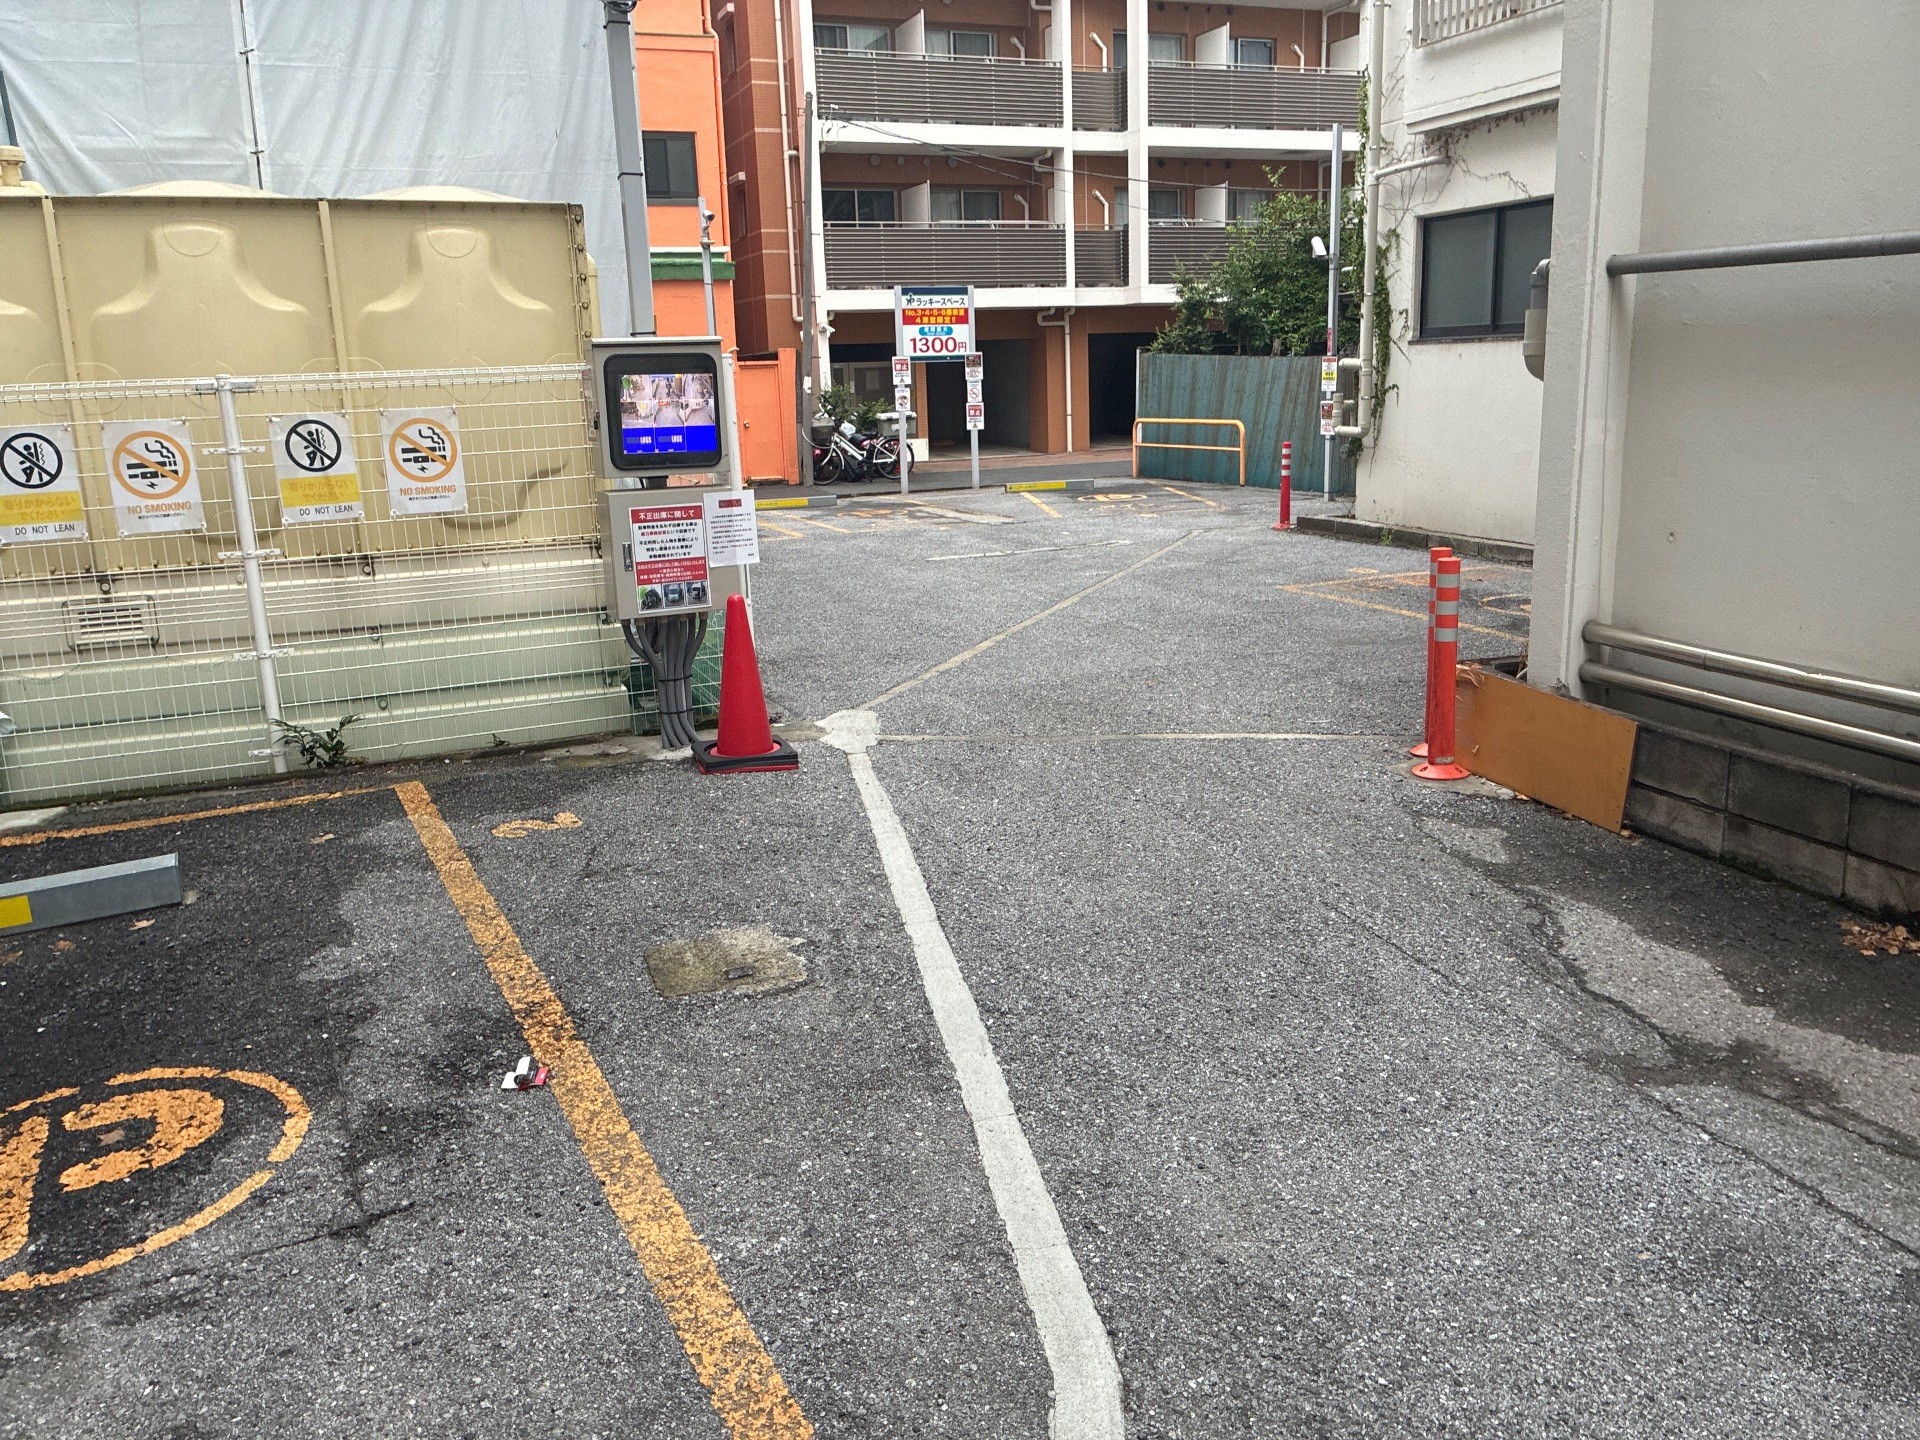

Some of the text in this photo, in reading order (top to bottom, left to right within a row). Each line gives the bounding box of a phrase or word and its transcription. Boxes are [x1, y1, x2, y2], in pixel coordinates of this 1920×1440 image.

[915, 297, 966, 306] ラッキースペース
[909, 336, 967, 354] 1300円
[399, 484, 457, 497] NO SMOKING
[127, 500, 192, 515] NO SMOKING
[299, 504, 354, 517] DO NOT LEAN
[638, 509, 695, 521] 不正出庫に関して
[14, 523, 75, 536] DO NOT LEAN
